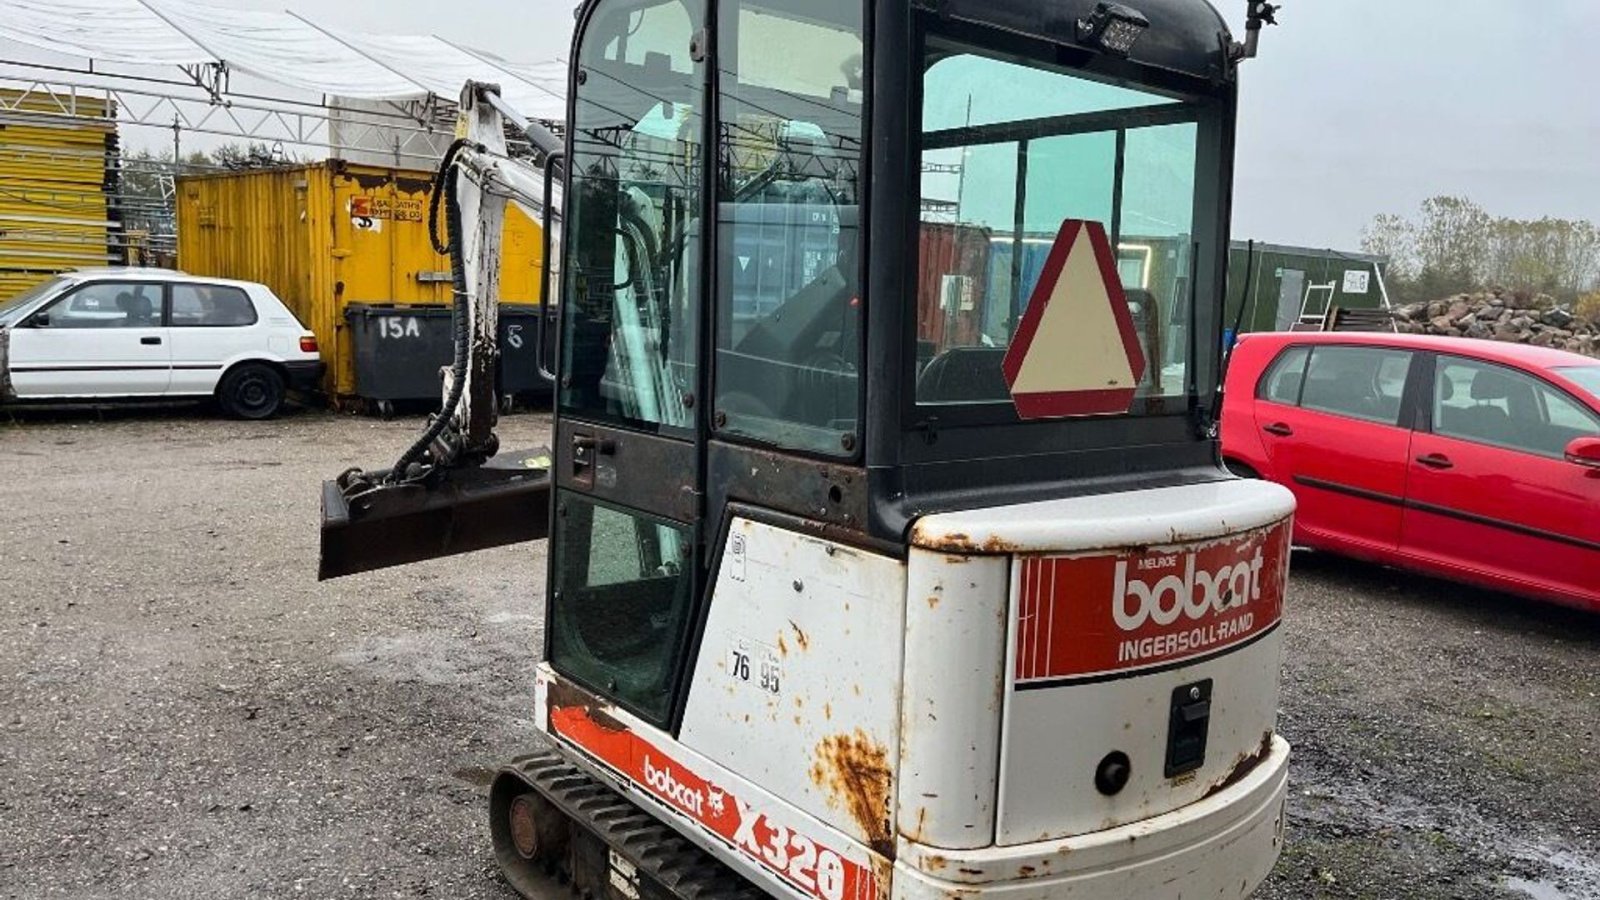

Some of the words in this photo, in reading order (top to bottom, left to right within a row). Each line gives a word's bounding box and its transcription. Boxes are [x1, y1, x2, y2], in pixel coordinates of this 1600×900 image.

[379, 316, 420, 339] 15A
[1137, 555, 1177, 570] MELROE
[1112, 545, 1264, 631] bobcat
[1118, 612, 1253, 662] INGERSOLL-RAND
[732, 650, 750, 681] 76
[642, 754, 704, 817] bobcat
